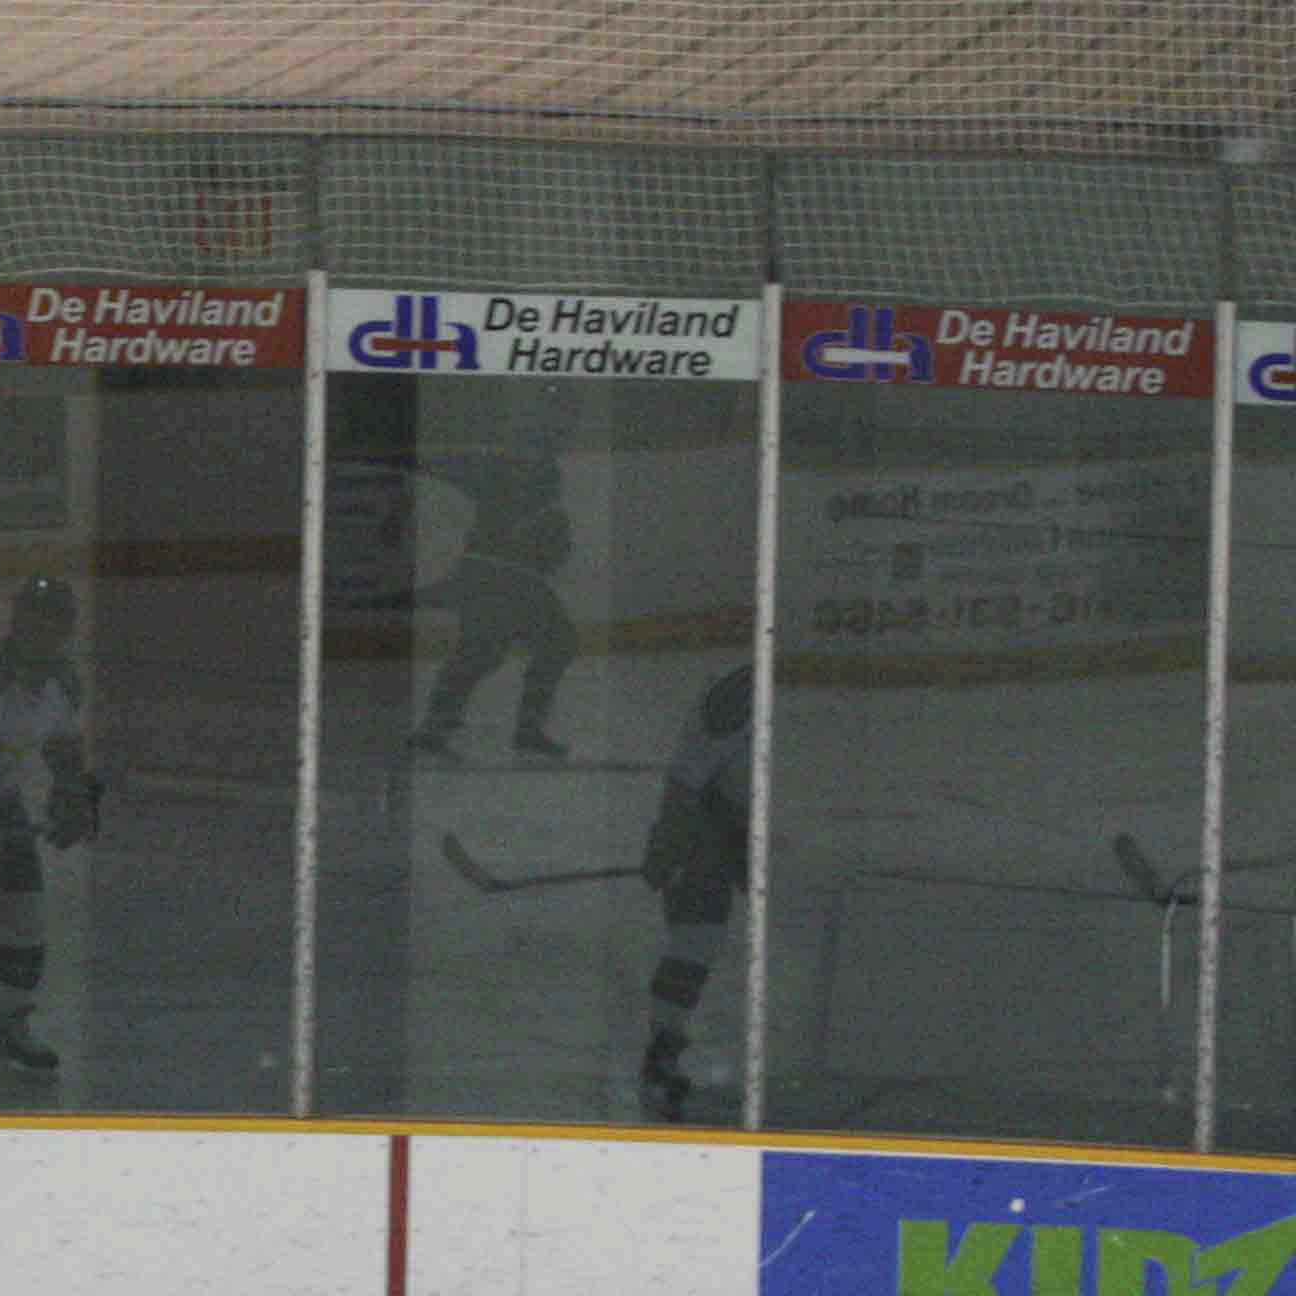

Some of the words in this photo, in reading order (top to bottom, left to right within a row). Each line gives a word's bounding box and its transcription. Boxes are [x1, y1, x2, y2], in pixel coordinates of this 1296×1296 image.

[27, 289, 86, 324] De
[94, 291, 283, 326] Haviland
[484, 299, 536, 334] De
[552, 302, 737, 338] Haviland
[50, 328, 257, 365] Hardware
[937, 311, 995, 346] De
[1002, 315, 1192, 356] Haviland
[508, 339, 712, 378] Hardware
[958, 351, 1166, 395] Hardware
